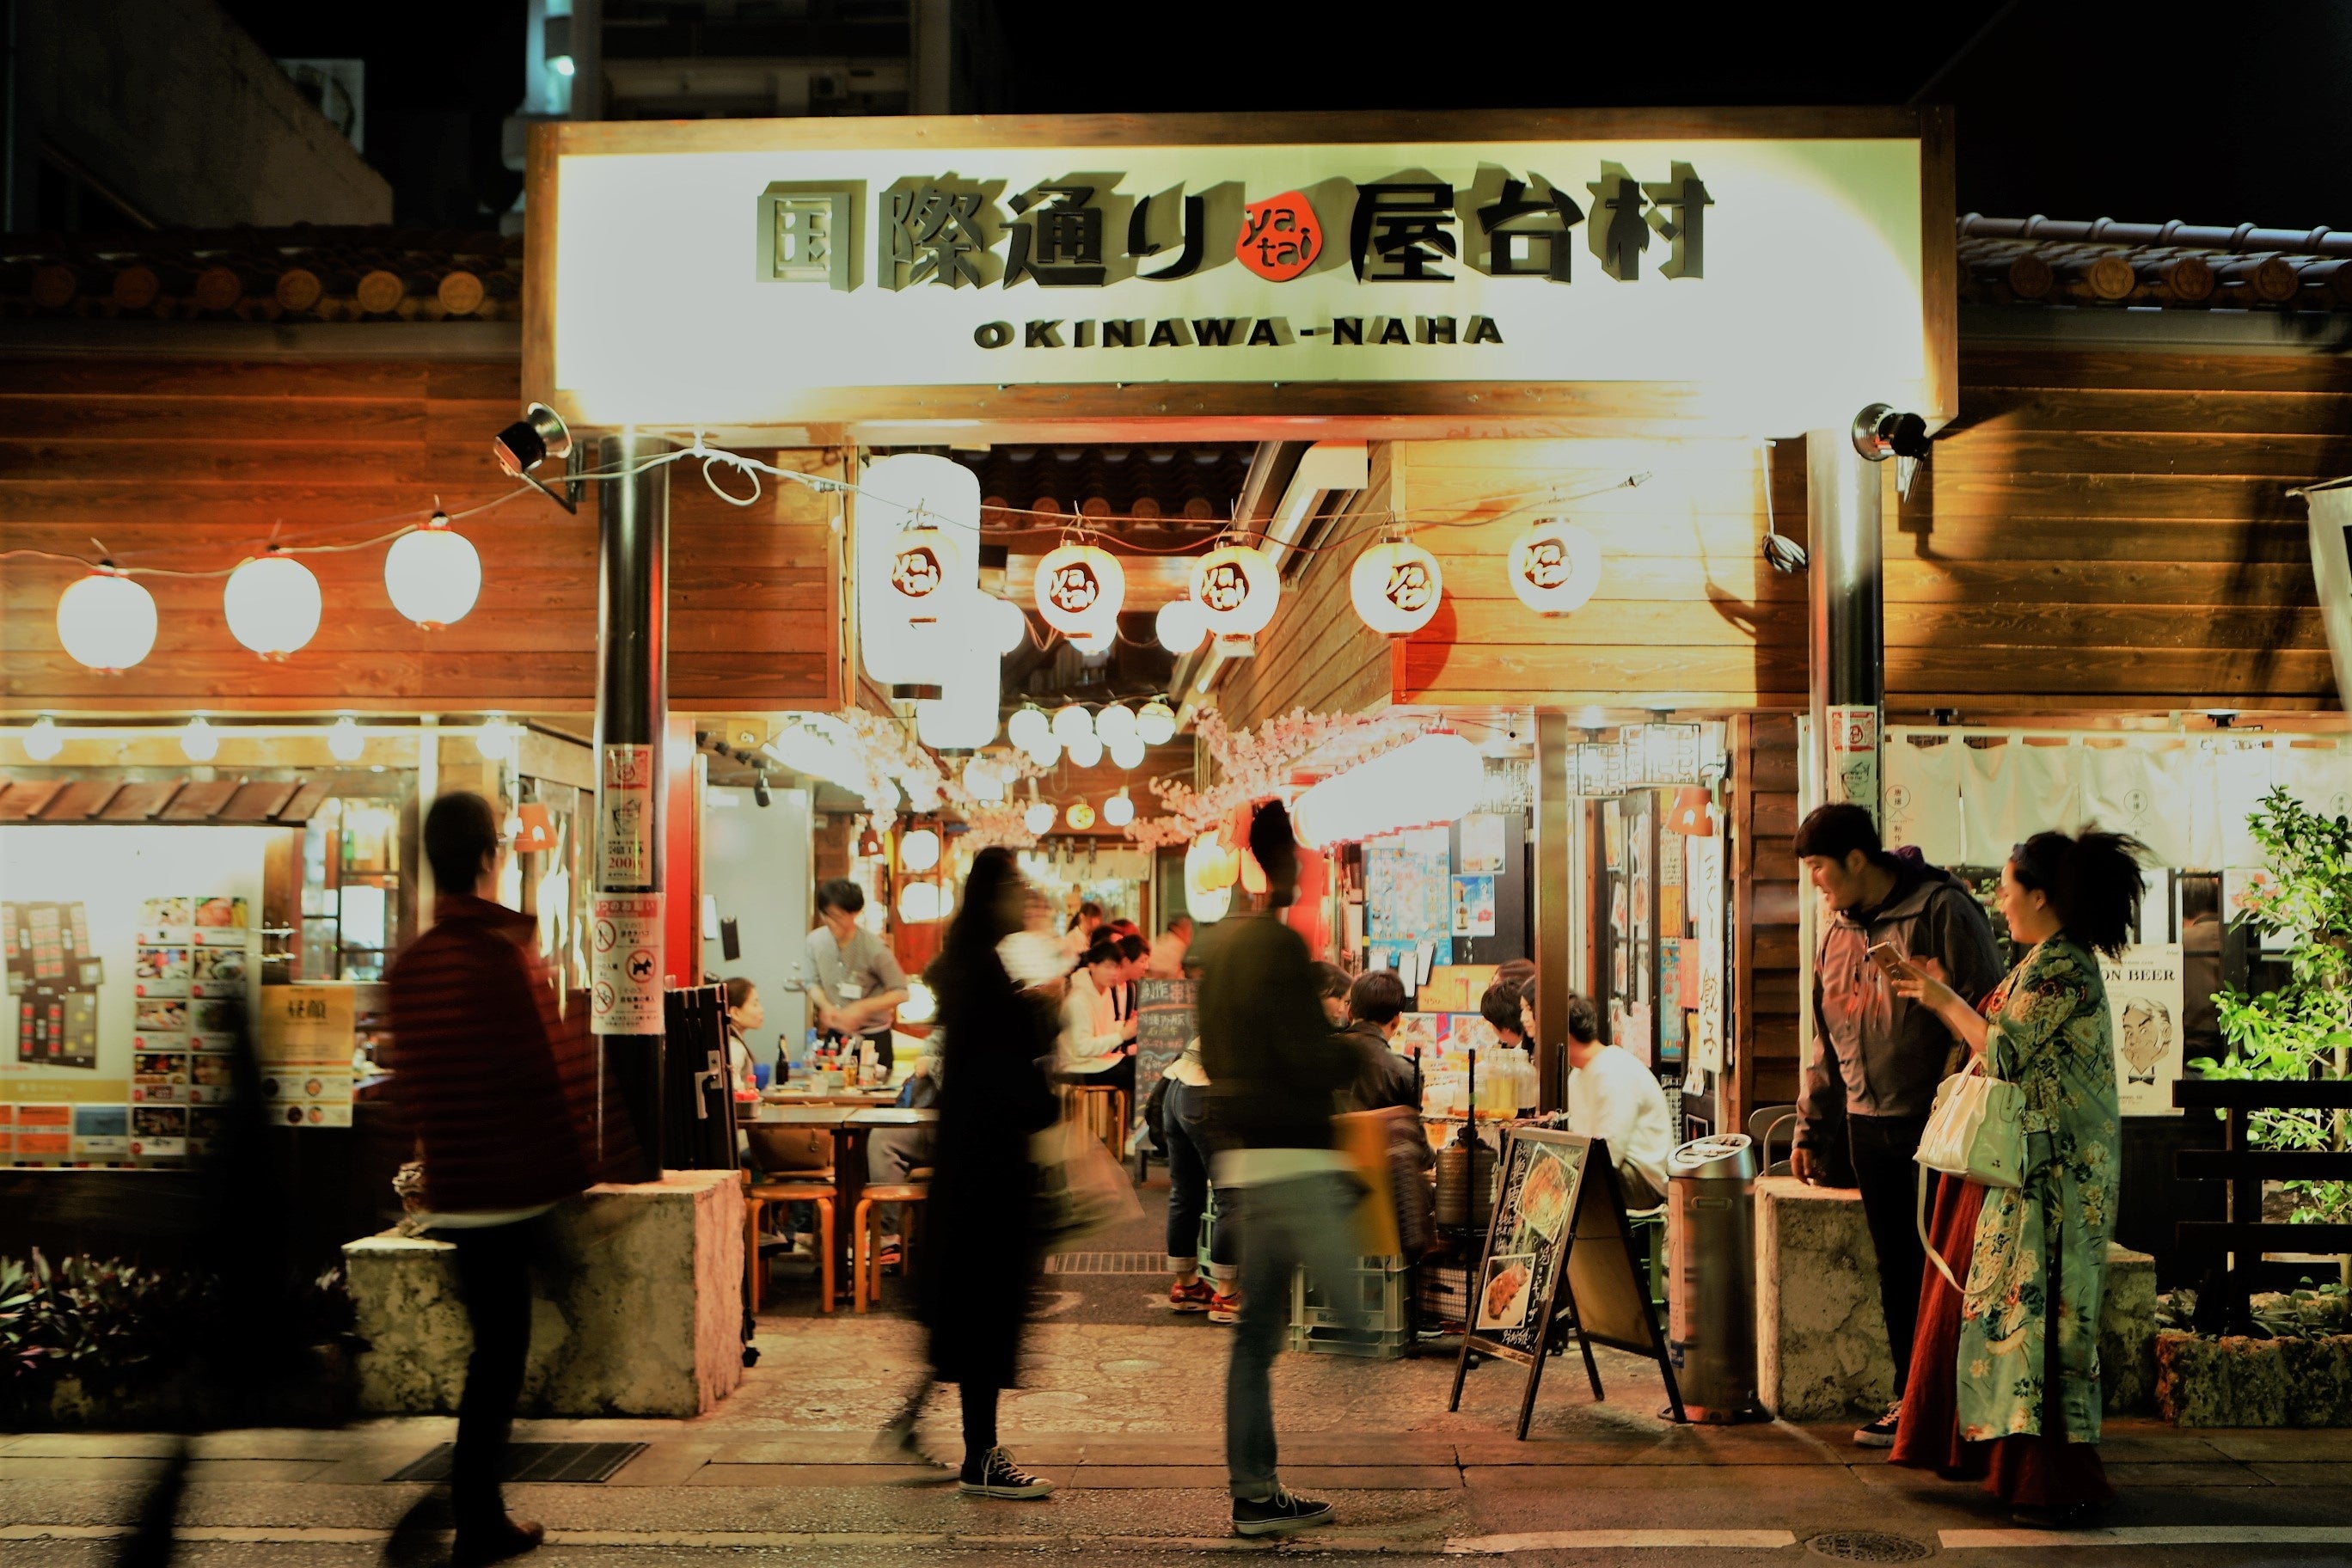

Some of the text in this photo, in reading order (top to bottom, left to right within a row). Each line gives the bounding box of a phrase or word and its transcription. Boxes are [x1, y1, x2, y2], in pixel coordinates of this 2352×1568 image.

[756, 186, 1204, 292] 国際通り
[1351, 178, 1715, 285] 屋台村
[2128, 969, 2176, 982] BEER
